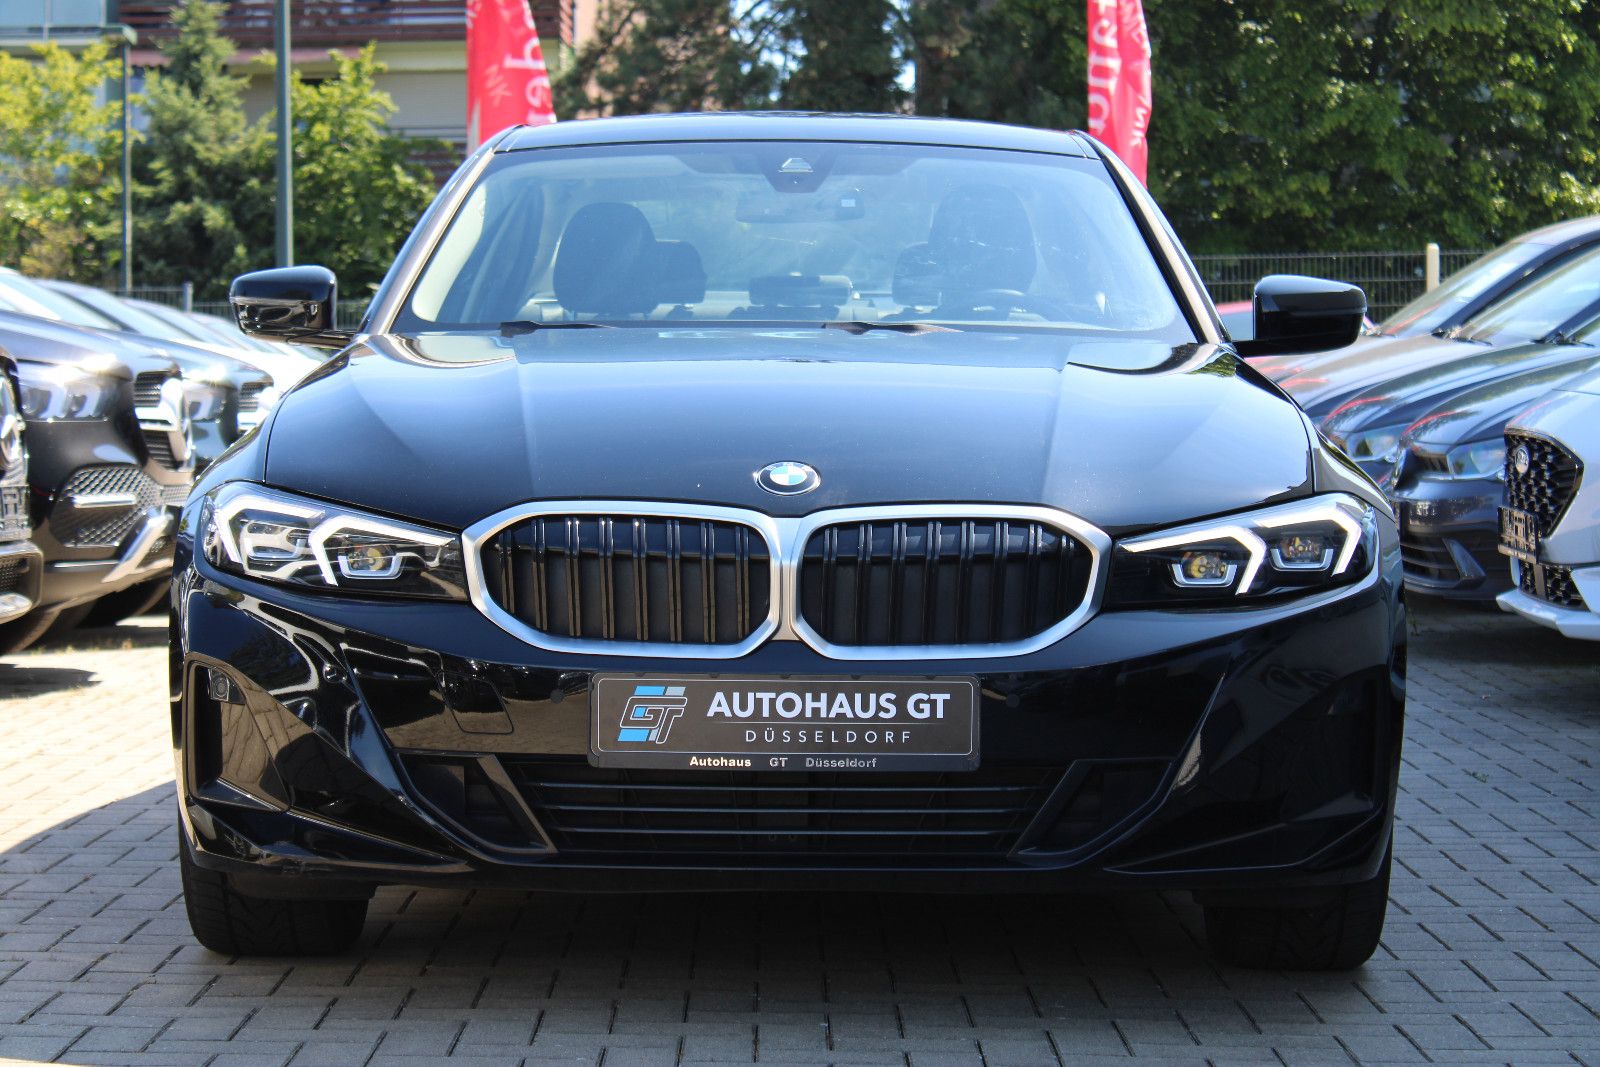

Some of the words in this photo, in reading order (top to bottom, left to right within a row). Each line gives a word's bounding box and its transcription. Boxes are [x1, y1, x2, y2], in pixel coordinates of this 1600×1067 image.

[706, 691, 897, 719] AUTOHAUS
[906, 692, 951, 719] GT
[745, 727, 911, 743] DÜSSELDORF
[689, 756, 752, 767] Autohaus
[769, 757, 788, 768] GT
[805, 757, 877, 768] Düsseldorf
